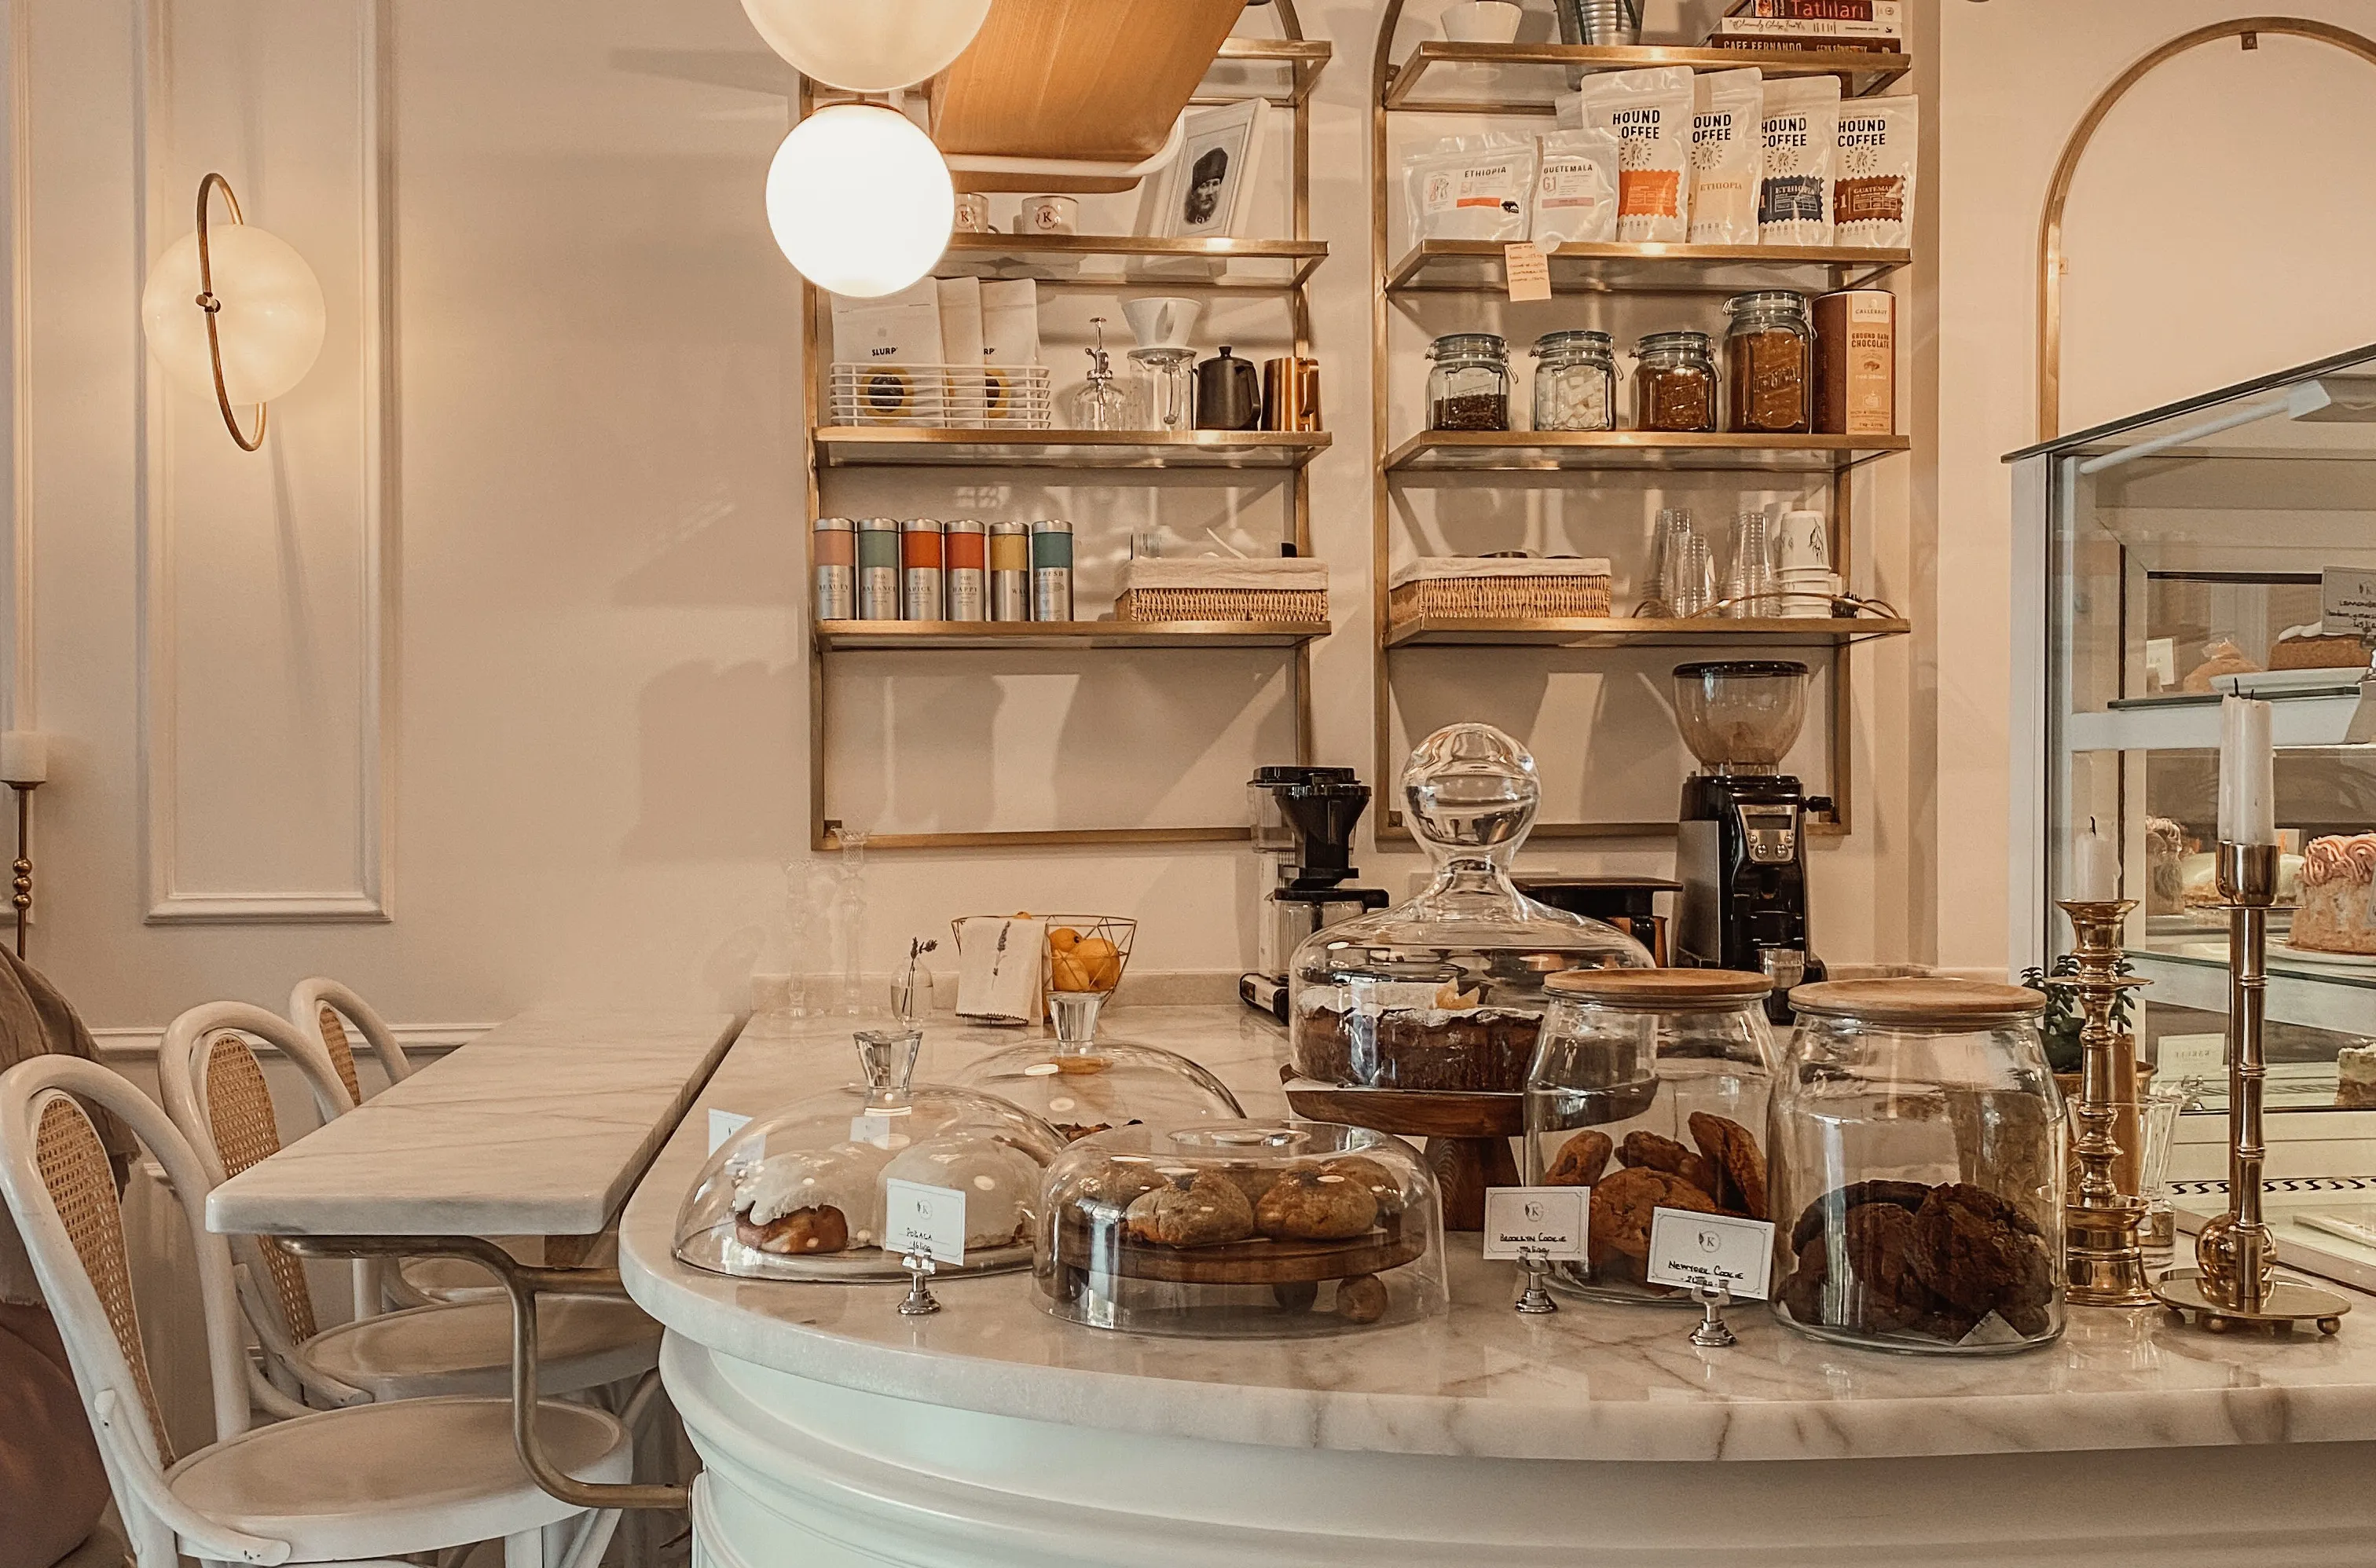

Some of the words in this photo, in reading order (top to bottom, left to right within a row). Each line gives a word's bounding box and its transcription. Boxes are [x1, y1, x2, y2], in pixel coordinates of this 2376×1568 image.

[1613, 110, 1660, 125] HOUND
[1694, 114, 1732, 128] OUND
[1761, 118, 1806, 134] HOUND
[1838, 119, 1886, 133] HOUND
[1618, 126, 1659, 139] OFFEE
[1692, 128, 1731, 143] OFFEE
[1838, 134, 1886, 148] COFFEE
[1465, 167, 1506, 178] ETHIOPIA
[1700, 181, 1742, 192] ETHIOPIA
[960, 211, 970, 222] K
[1043, 211, 1052, 222] K
[1851, 339, 1890, 349] CHOCOLATE
[871, 347, 896, 357] SLURP
[1532, 1207, 1538, 1216] K
[1707, 1236, 1714, 1247] K
